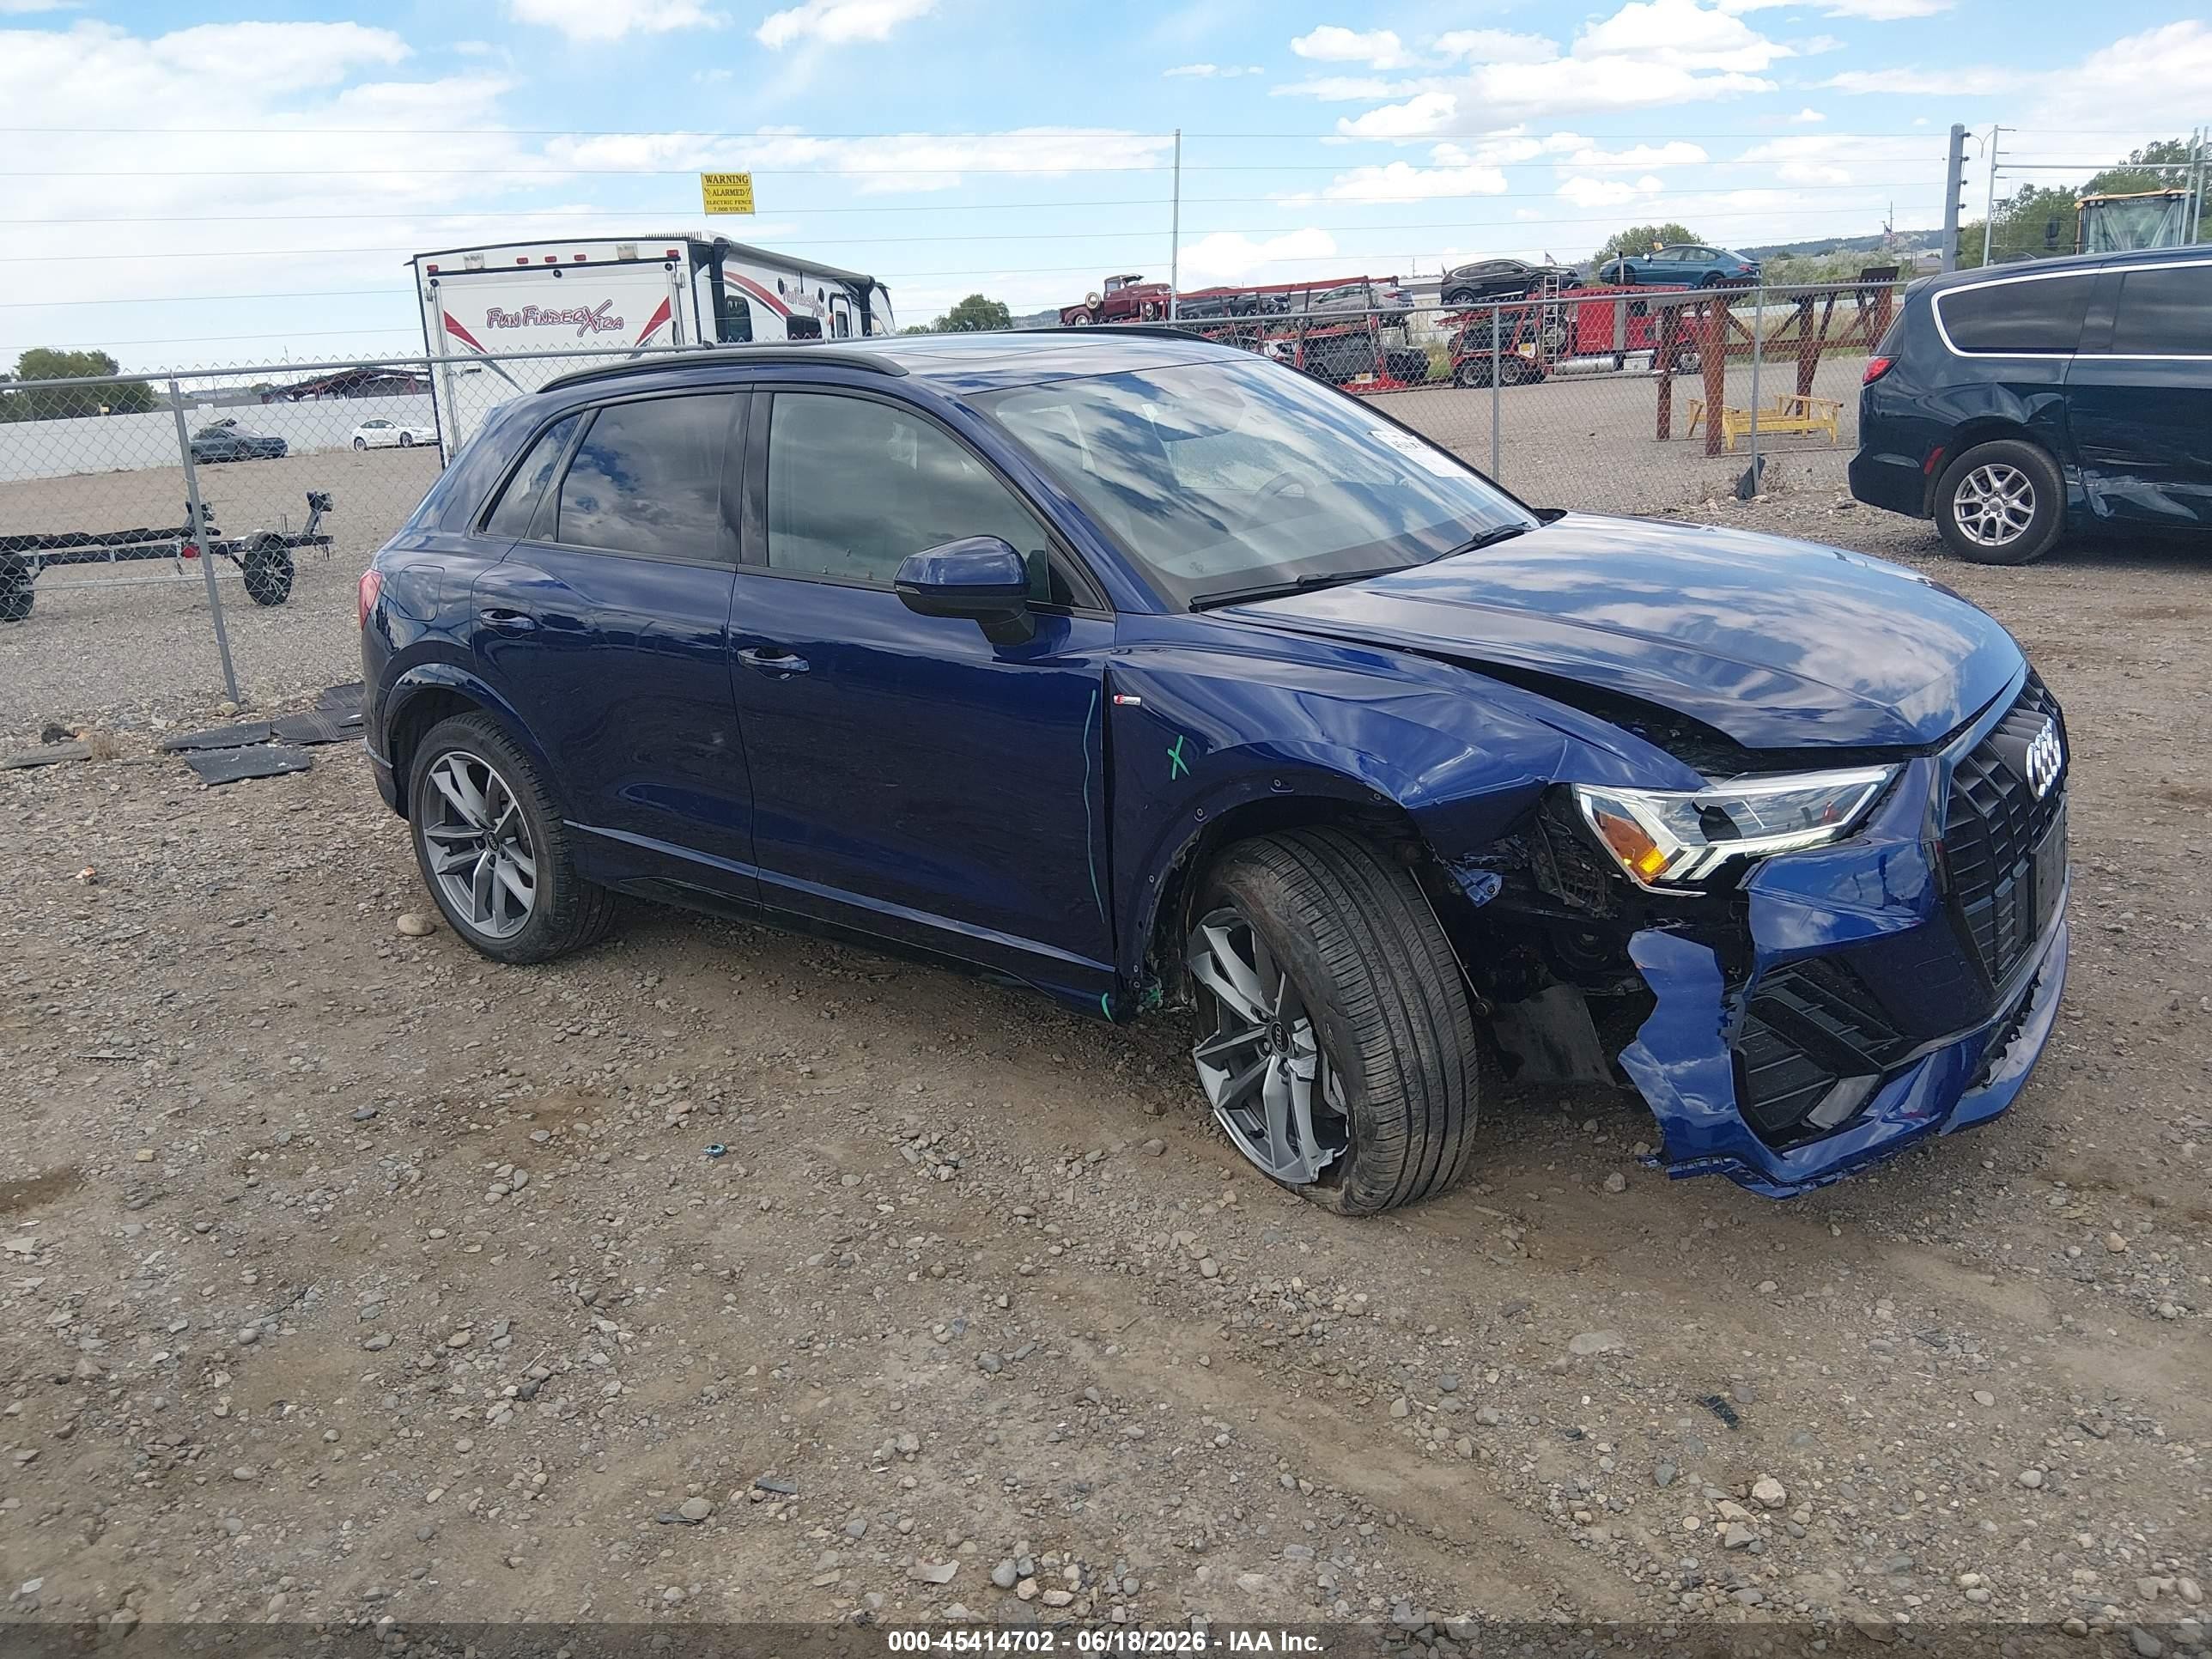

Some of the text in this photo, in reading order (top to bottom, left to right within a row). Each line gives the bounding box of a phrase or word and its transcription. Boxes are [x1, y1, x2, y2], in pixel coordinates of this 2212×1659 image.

[705, 174, 749, 184] WARNING
[712, 188, 745, 197] ALARMED
[487, 307, 521, 328] FUN
